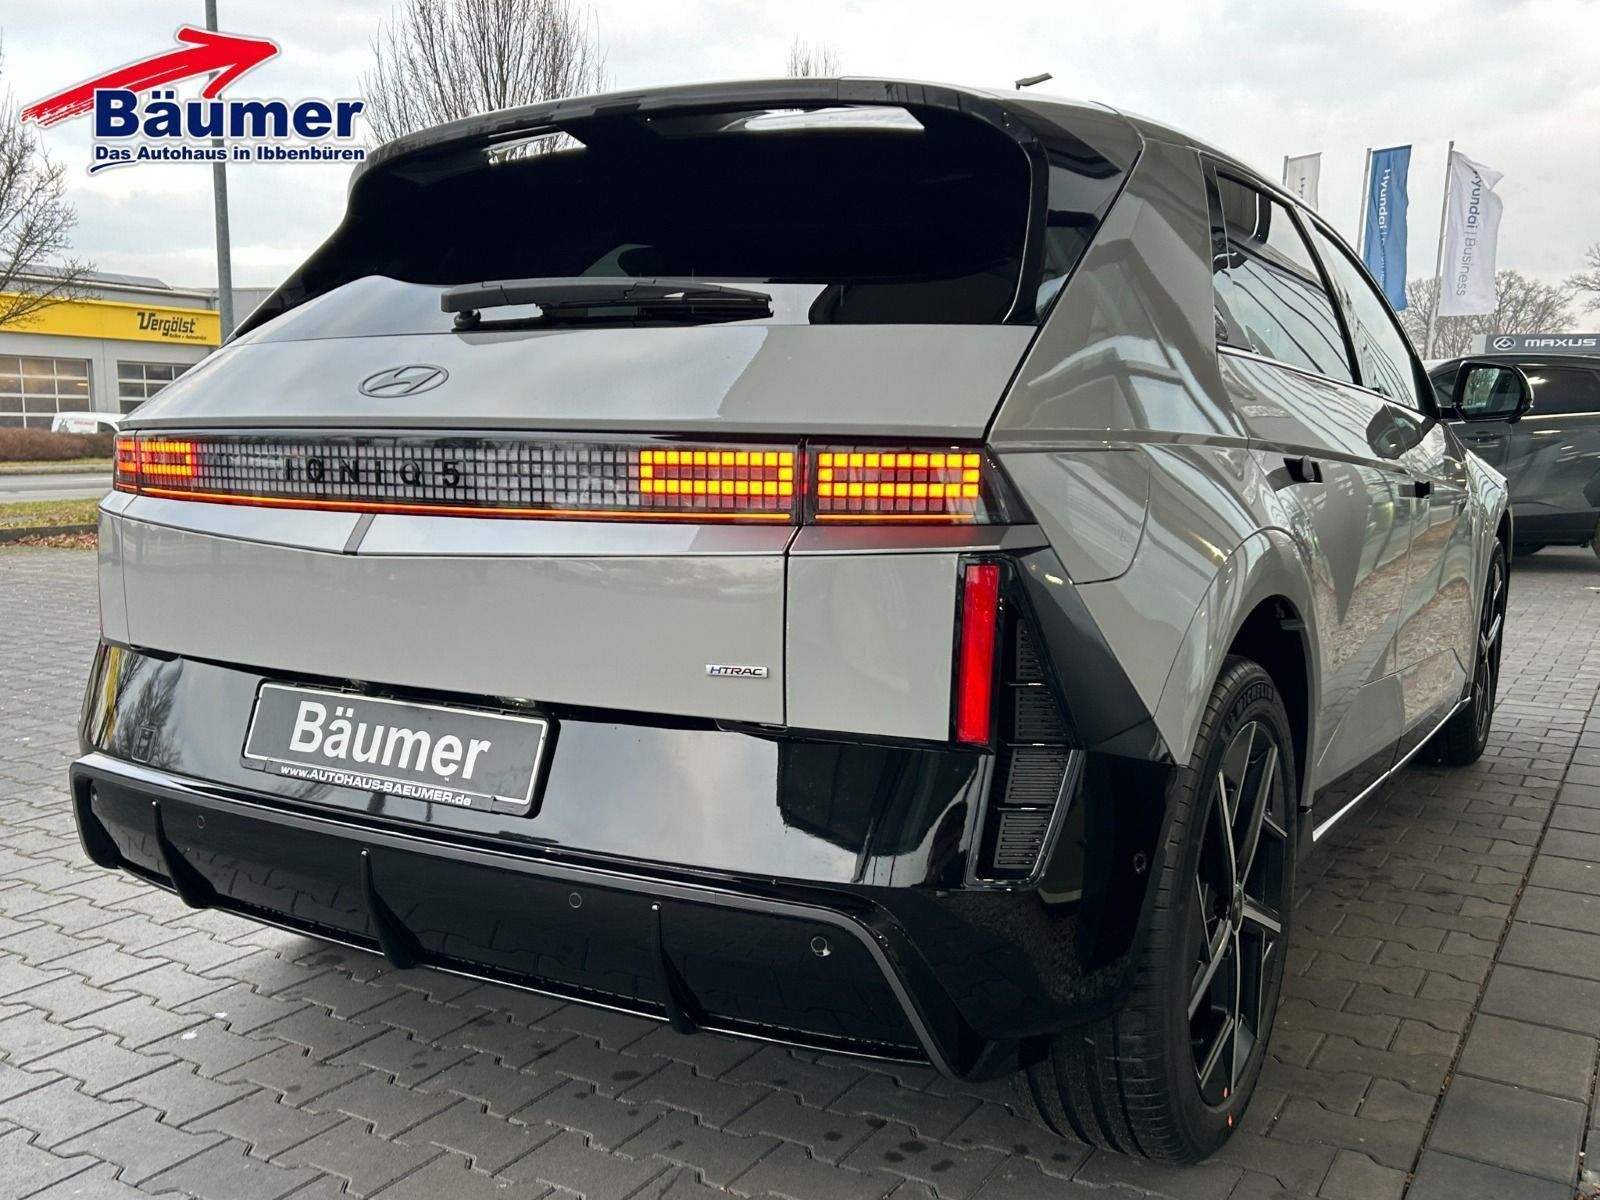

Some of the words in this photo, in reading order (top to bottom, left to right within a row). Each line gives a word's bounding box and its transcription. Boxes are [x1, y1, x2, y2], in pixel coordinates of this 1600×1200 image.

[1378, 168, 1392, 229] Hyundai
[1456, 237, 1478, 297] Business
[137, 311, 197, 337] Vergölst
[1524, 338, 1598, 348] MAXUS
[285, 457, 422, 488] IONIQ
[442, 461, 461, 488] 5
[709, 666, 763, 677] HTRAC
[288, 700, 493, 780] Bäumer
[280, 764, 473, 807] www.AUTOHAUS-BAEUMER.de
